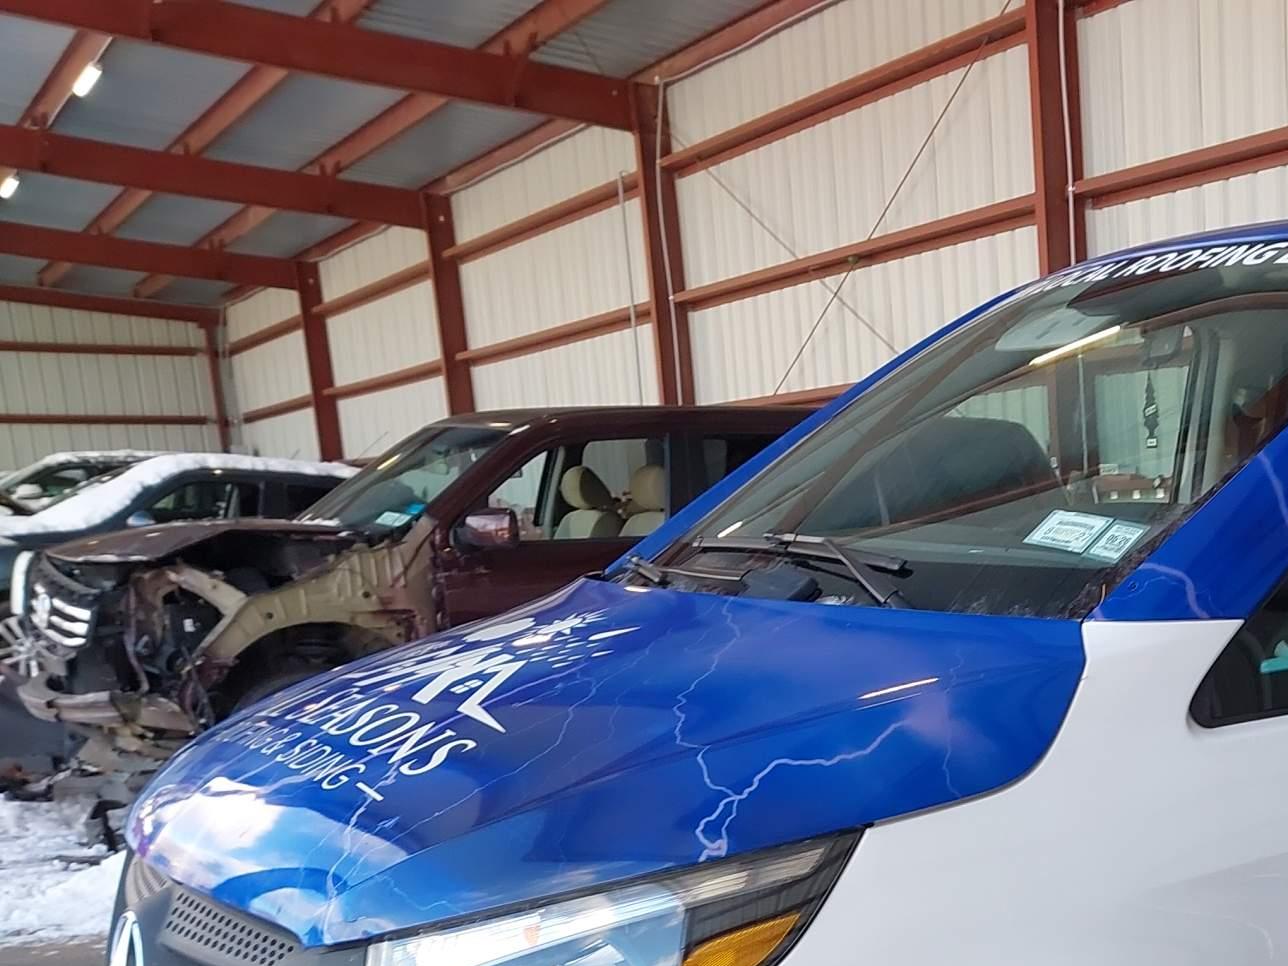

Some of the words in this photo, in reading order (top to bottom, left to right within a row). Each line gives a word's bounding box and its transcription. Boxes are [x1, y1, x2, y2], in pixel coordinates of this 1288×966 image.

[260, 732, 302, 756] &
[285, 688, 477, 775] SEASONS
[276, 739, 366, 789] SIDING
